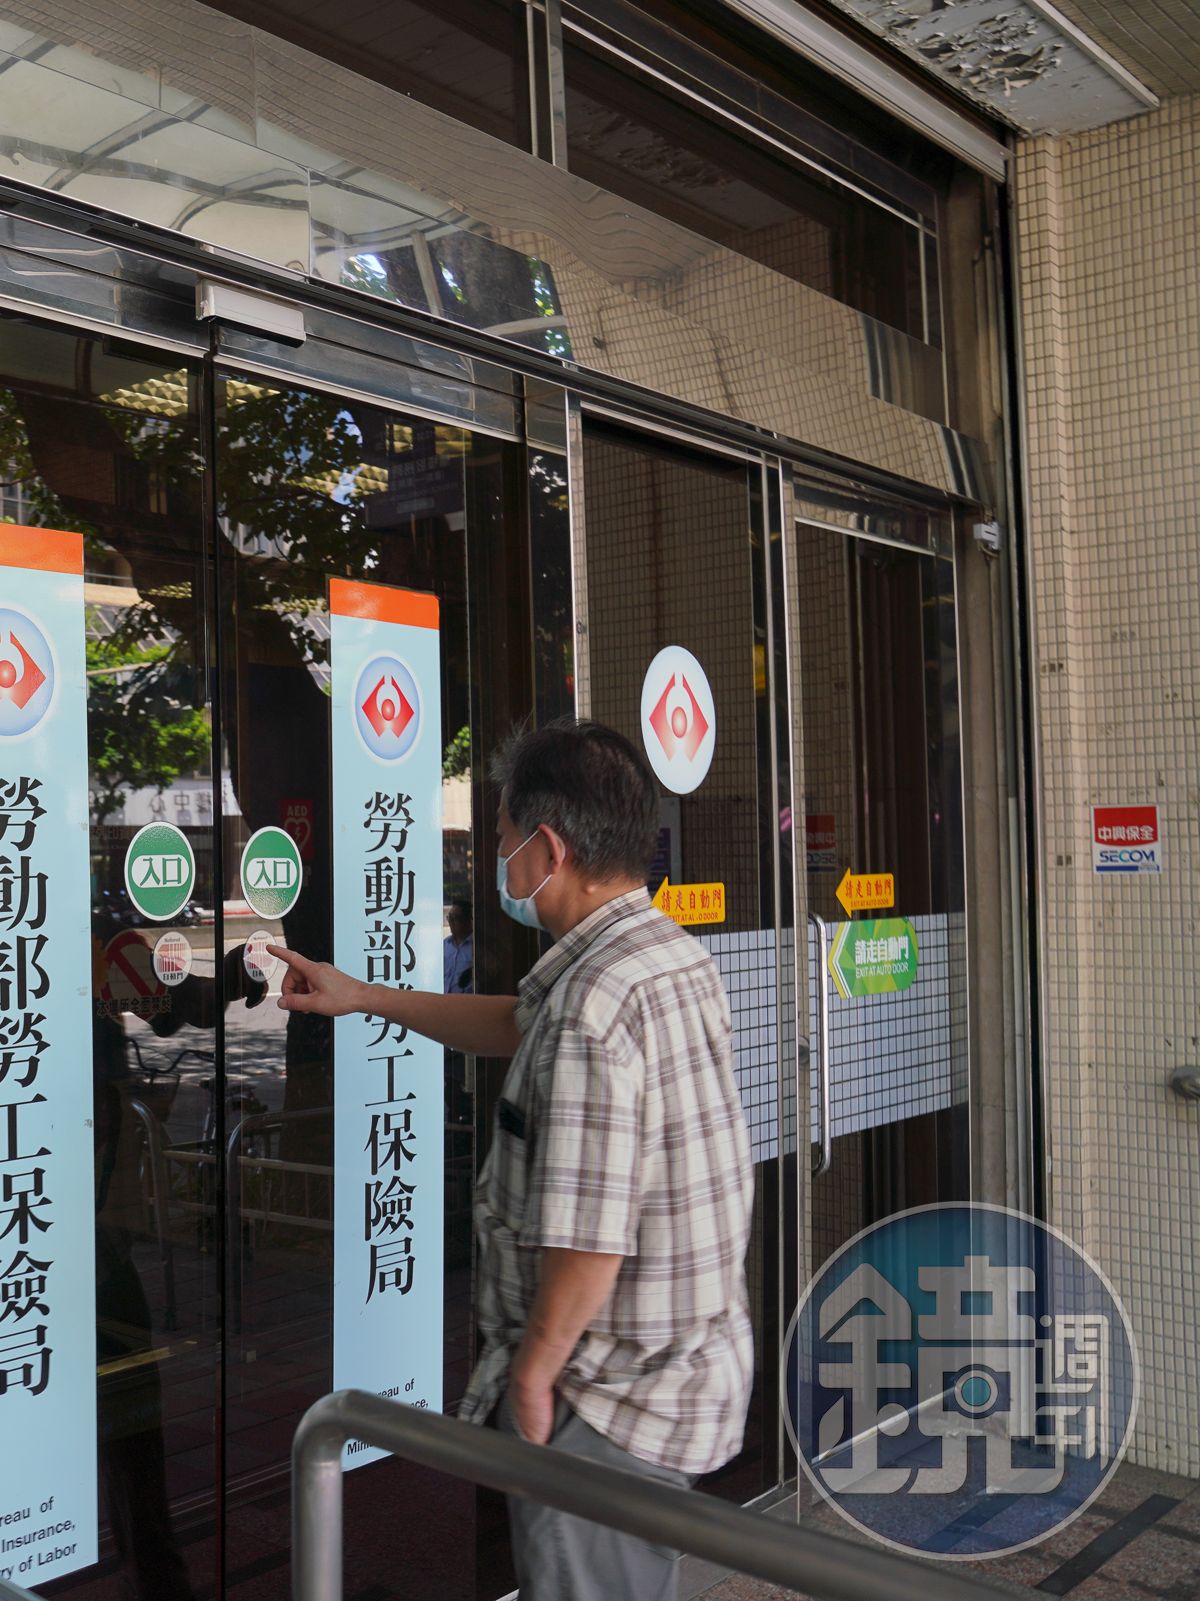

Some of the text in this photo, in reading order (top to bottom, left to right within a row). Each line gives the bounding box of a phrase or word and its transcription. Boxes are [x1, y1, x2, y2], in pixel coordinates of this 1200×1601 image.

[287, 805, 308, 817] AED
[1097, 825, 1154, 841] 中興保全
[1099, 850, 1155, 863] SECOM
[140, 857, 182, 887] 入口
[254, 860, 290, 887] 入口
[846, 878, 892, 899] 請走自動門
[661, 889, 722, 912] 請走自動門
[855, 936, 909, 965] 請走自動門
[856, 967, 869, 979] EXIT
[877, 964, 892, 976] AUTO
[893, 962, 909, 974] DOOR
[404, 1378, 415, 1392] of
[39, 1496, 54, 1513] of
[2, 1519, 76, 1552] Insurance,
[19, 1556, 34, 1574] of
[38, 1542, 78, 1567] Labor
